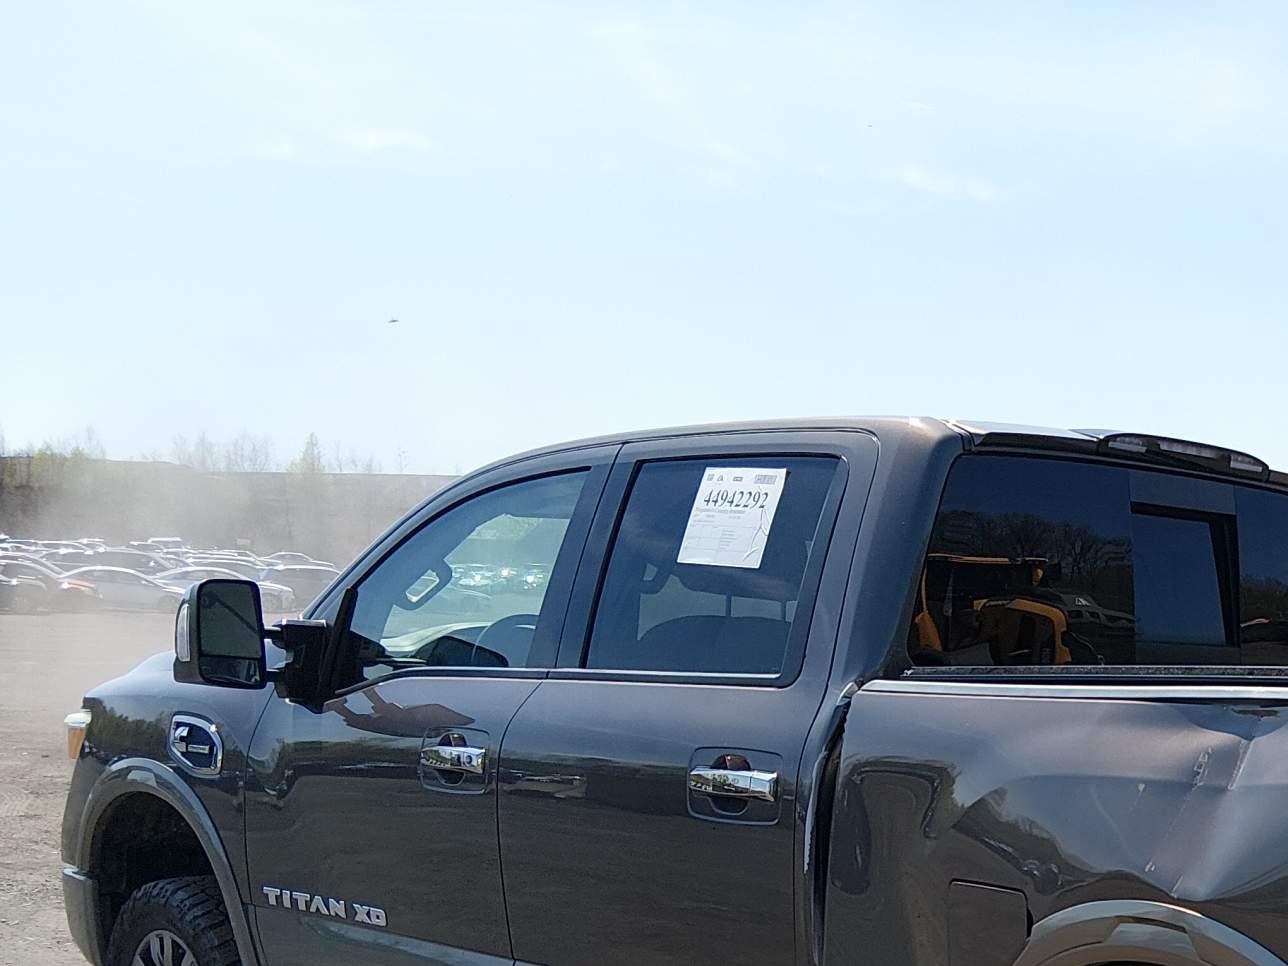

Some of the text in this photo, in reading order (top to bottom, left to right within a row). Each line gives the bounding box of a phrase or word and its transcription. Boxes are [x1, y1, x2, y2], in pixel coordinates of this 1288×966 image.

[703, 488, 769, 509] 44942292
[262, 886, 388, 927] TITAN XD
